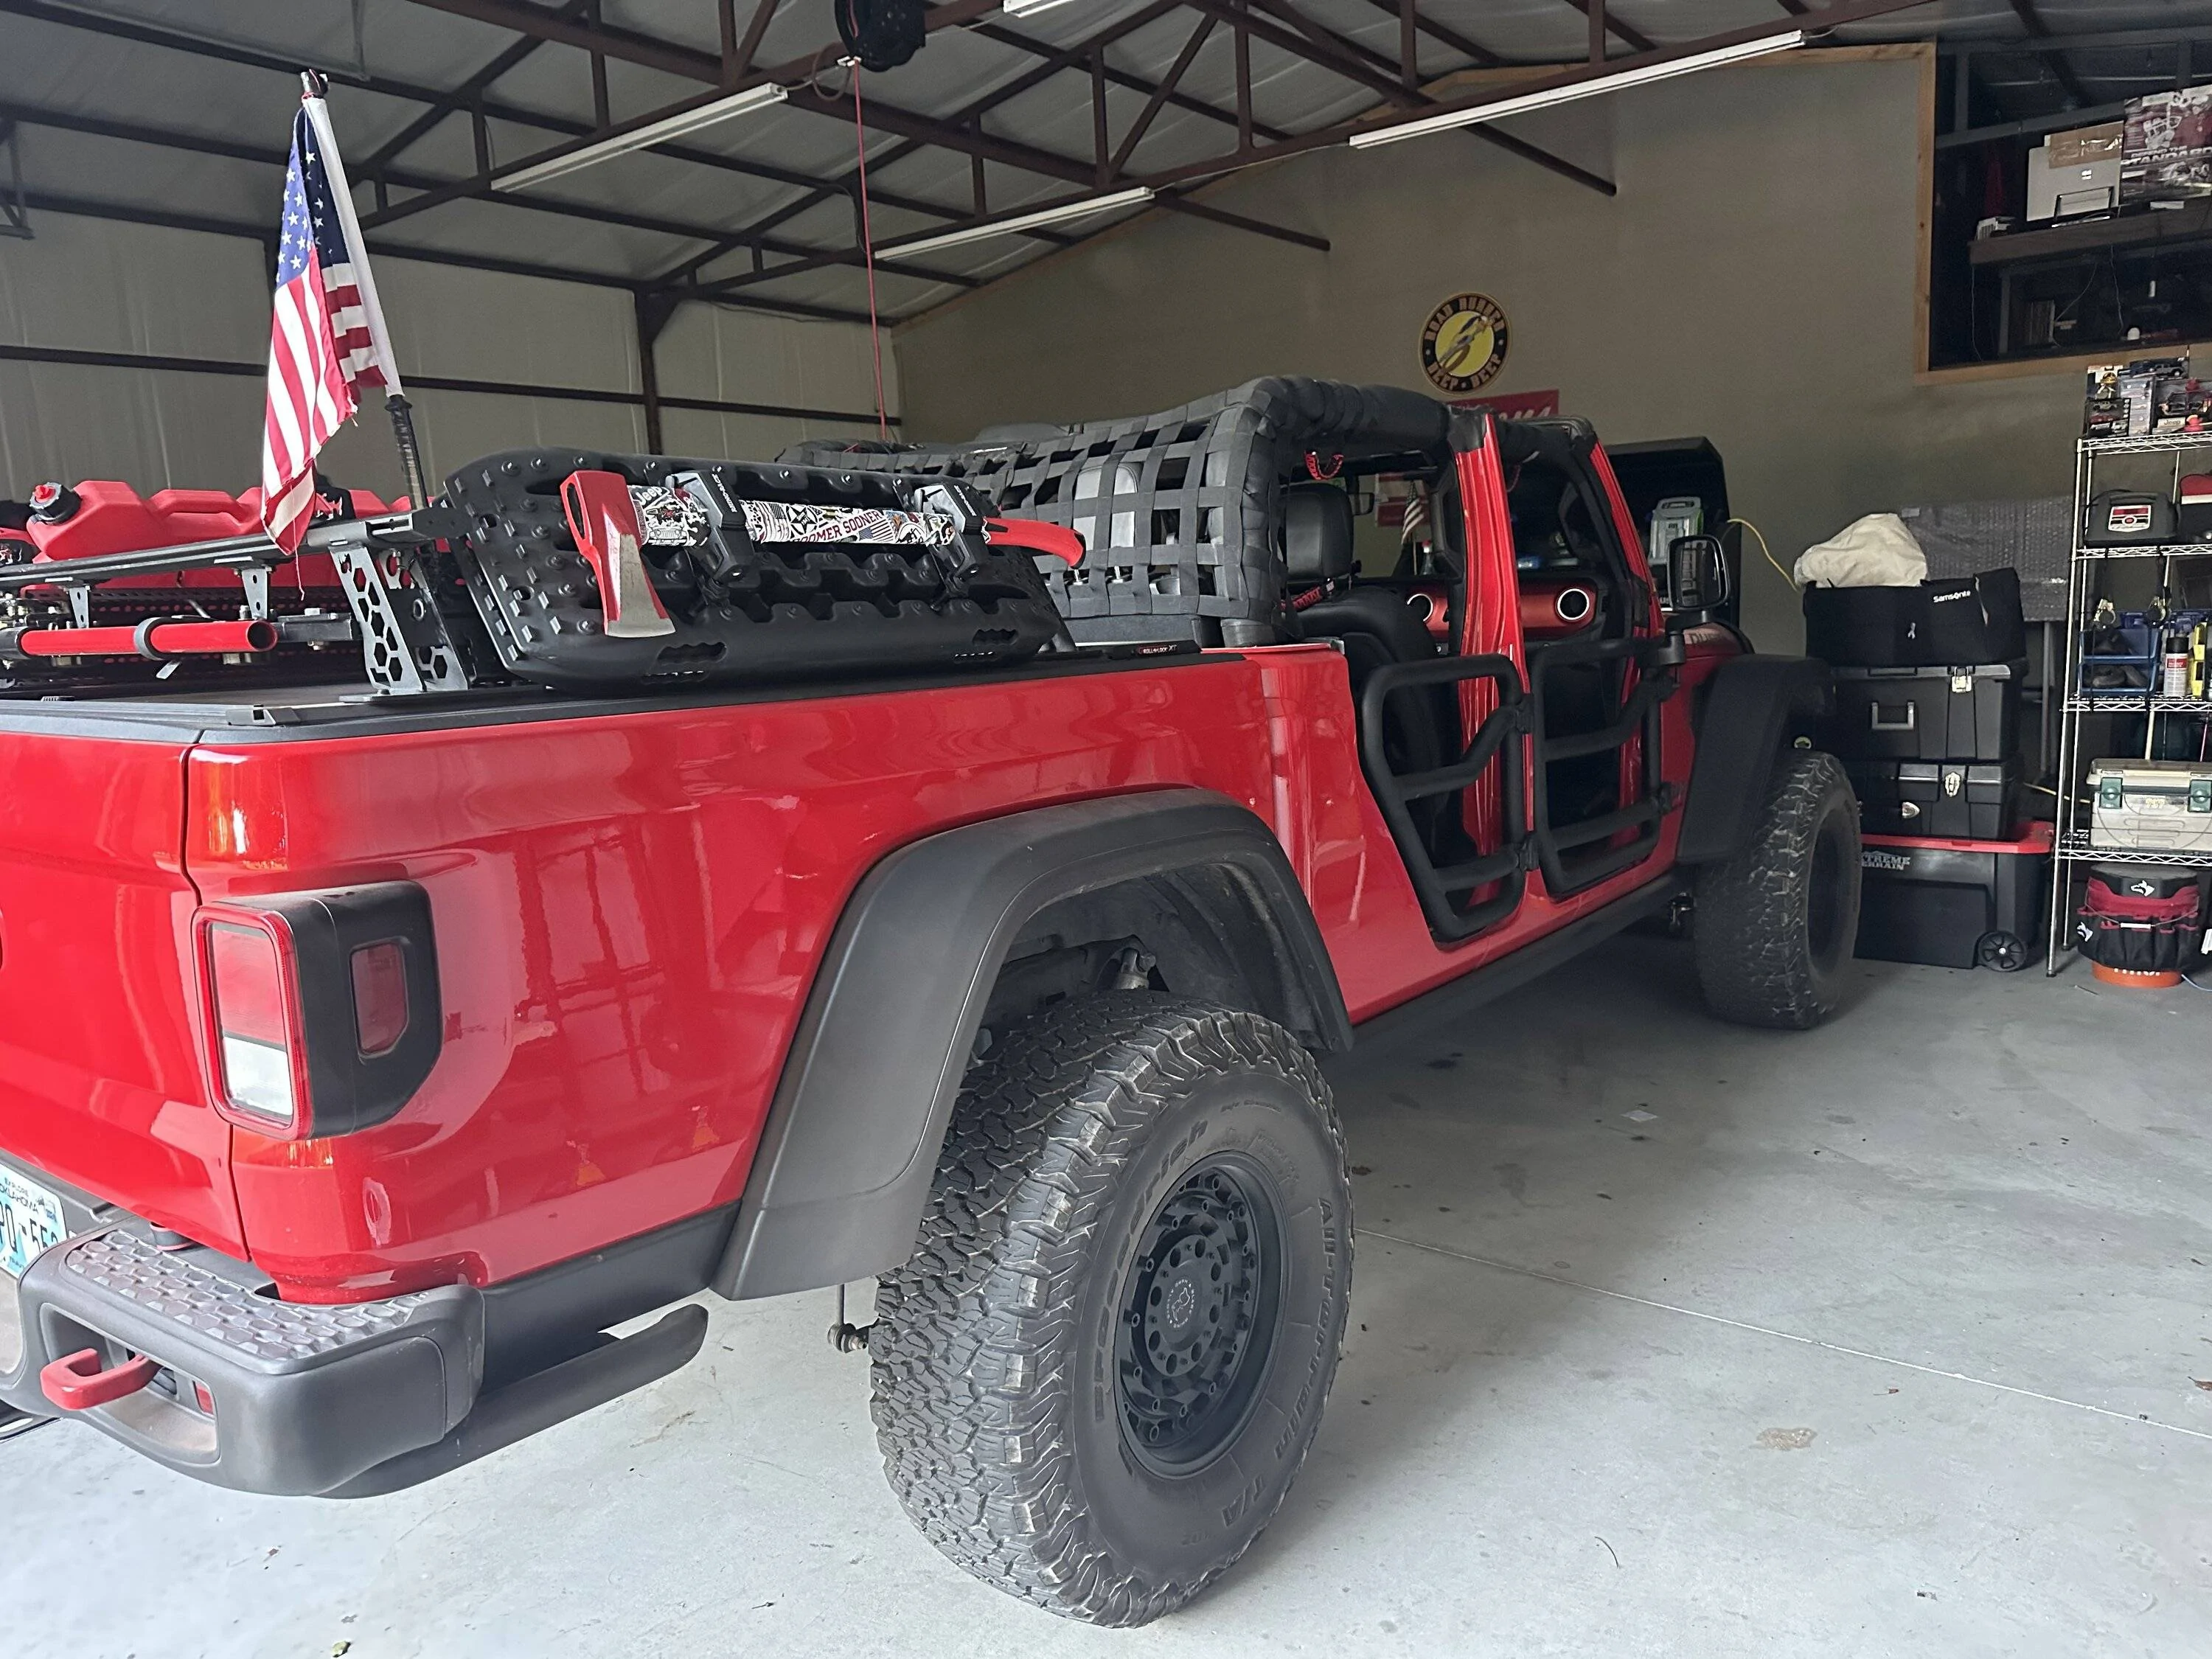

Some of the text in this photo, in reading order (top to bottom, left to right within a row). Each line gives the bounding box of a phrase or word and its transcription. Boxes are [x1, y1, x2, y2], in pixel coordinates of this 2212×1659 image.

[1425, 296, 1505, 341] ROAD RUNNER
[636, 487, 663, 506] Jeep
[842, 512, 883, 534] SOONER
[1221, 1473, 1267, 1528] T/A
